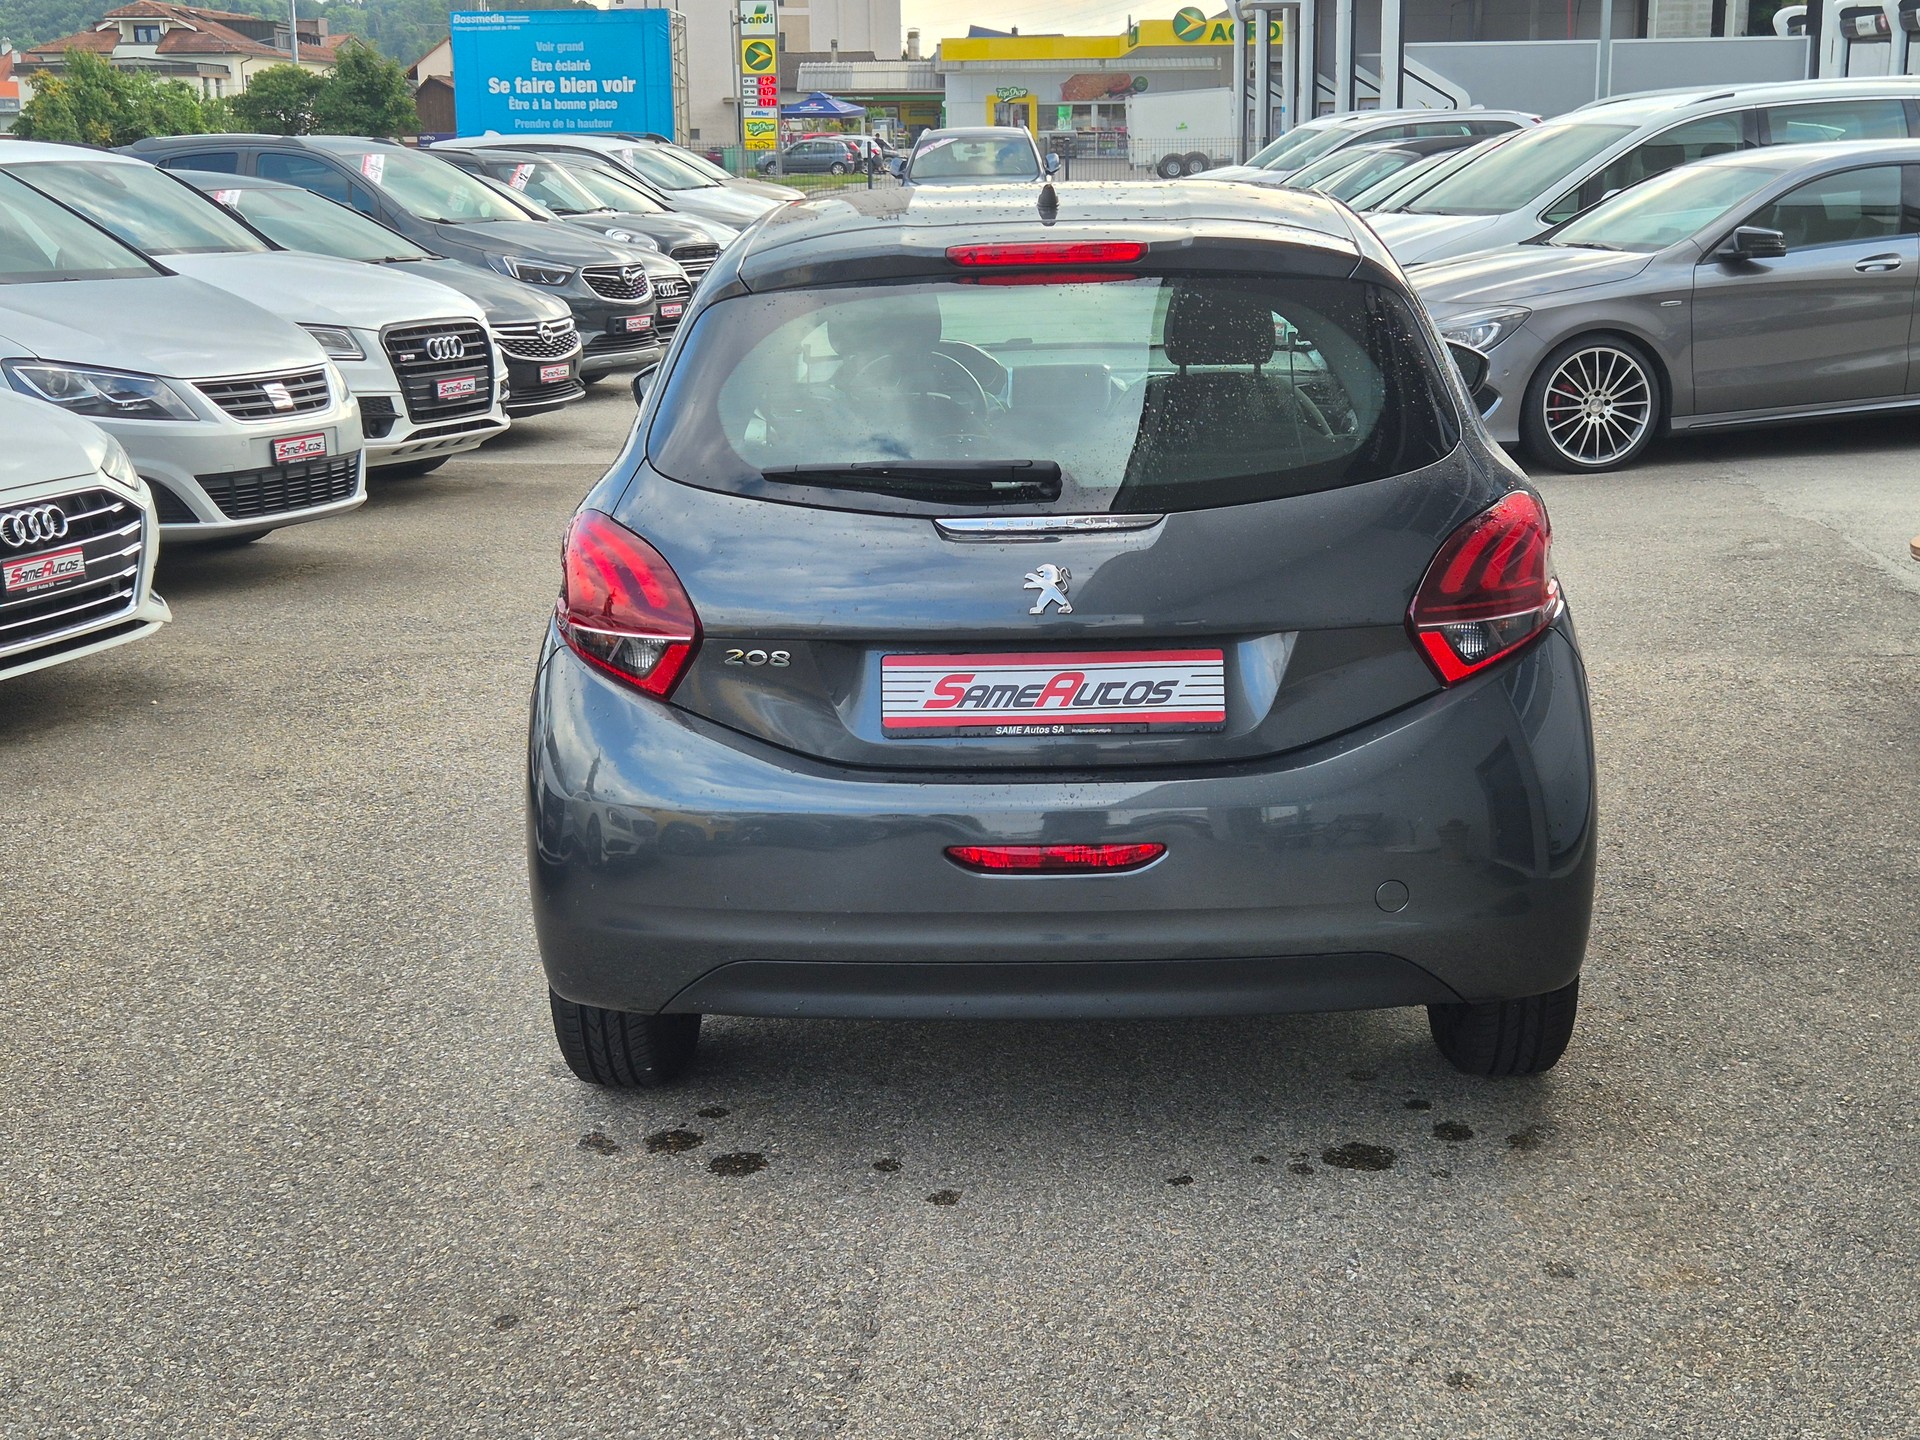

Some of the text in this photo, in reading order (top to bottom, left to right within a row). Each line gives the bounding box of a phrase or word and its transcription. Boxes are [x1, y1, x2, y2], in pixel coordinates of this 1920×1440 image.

[453, 14, 505, 23] Bossmedia
[743, 13, 773, 24] Landi
[536, 41, 584, 53] Voir grand
[531, 57, 591, 71] Être éclairé
[488, 76, 636, 94] Se faire bien voir
[508, 96, 618, 112] Être à la bonne place
[514, 118, 613, 129] Prendre de la hauteur
[724, 648, 791, 668] 208
[995, 726, 1023, 735] SAME
[1023, 725, 1050, 735] Autos
[1051, 725, 1065, 734] SA
